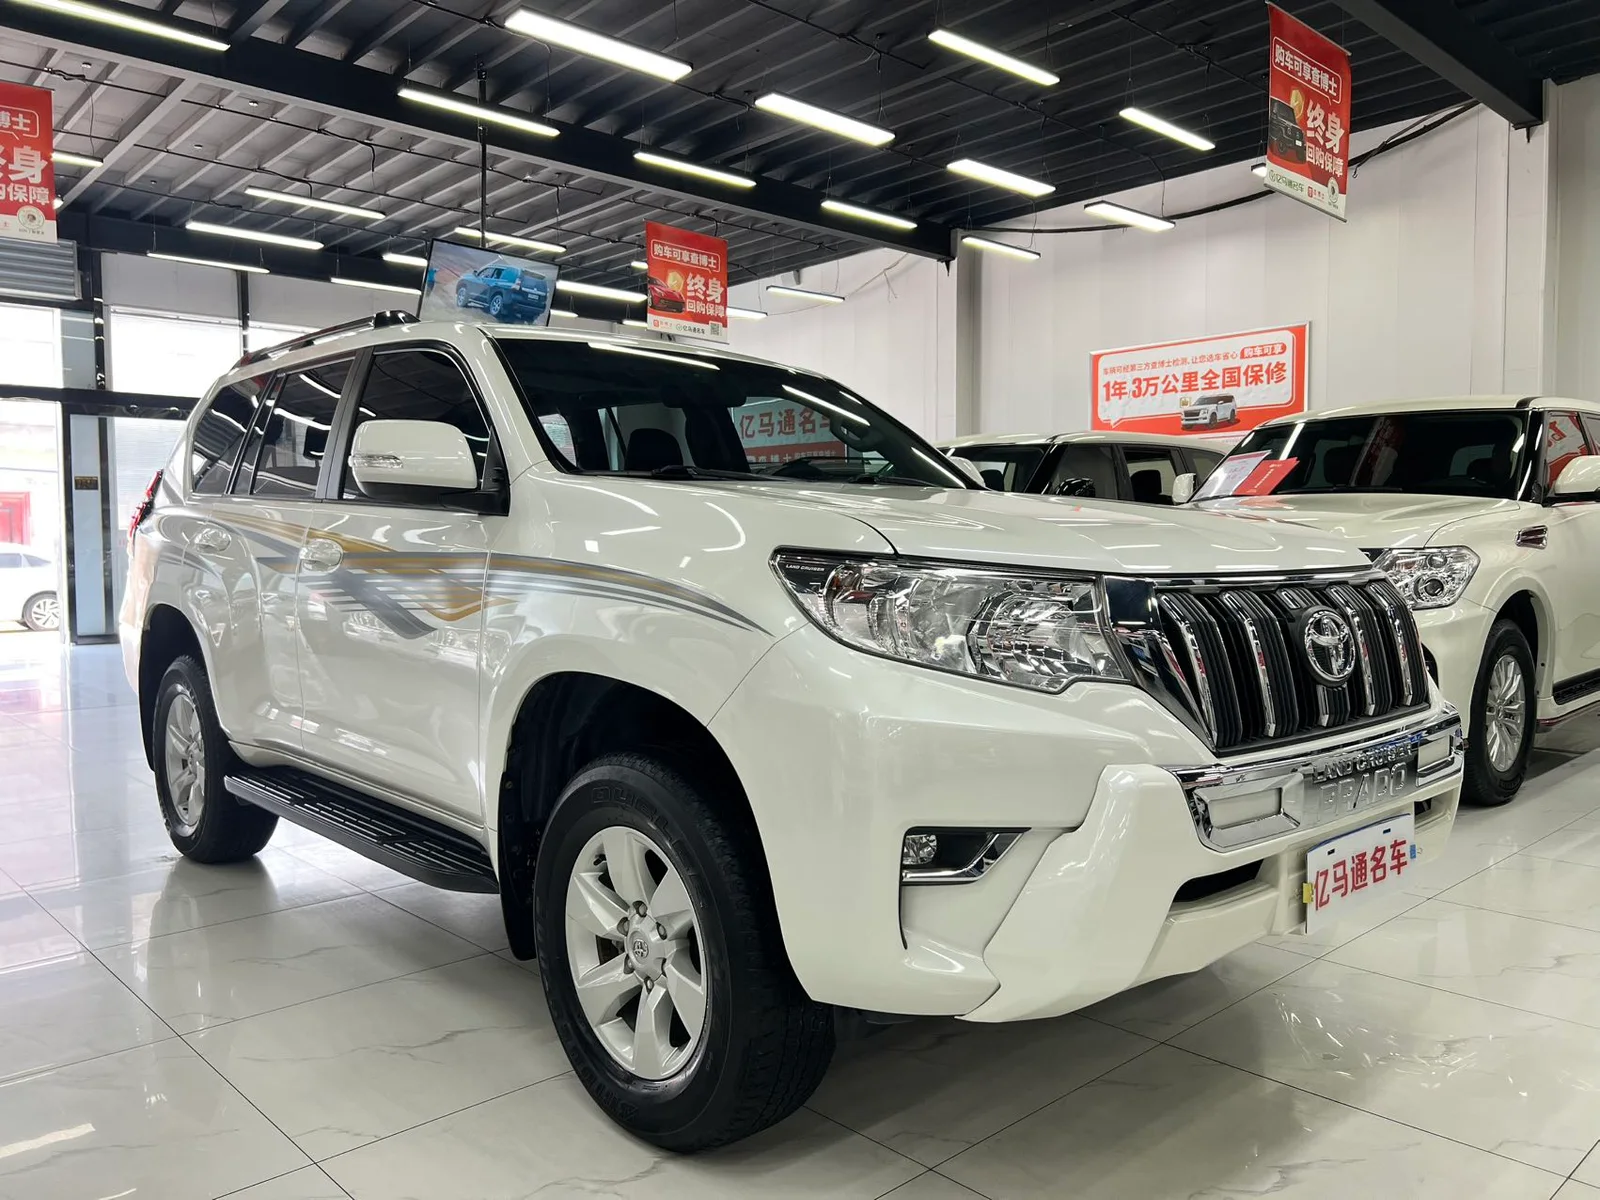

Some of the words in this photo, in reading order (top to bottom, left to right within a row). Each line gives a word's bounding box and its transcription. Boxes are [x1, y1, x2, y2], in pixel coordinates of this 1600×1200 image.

[1275, 44, 1337, 97] 购车可享查博士
[1306, 98, 1345, 154] 终身
[0, 145, 48, 184] 身
[1306, 141, 1344, 178] 回购保障
[0, 182, 50, 206] 保障
[653, 243, 717, 269] 购车可享查博士
[686, 272, 725, 304] 终身
[686, 300, 726, 318] 回购保障
[1243, 343, 1283, 358] 购车可享
[1313, 758, 1354, 784] LAND
[1318, 761, 1407, 817] PRADO
[1313, 839, 1408, 911] 亿马通名车
